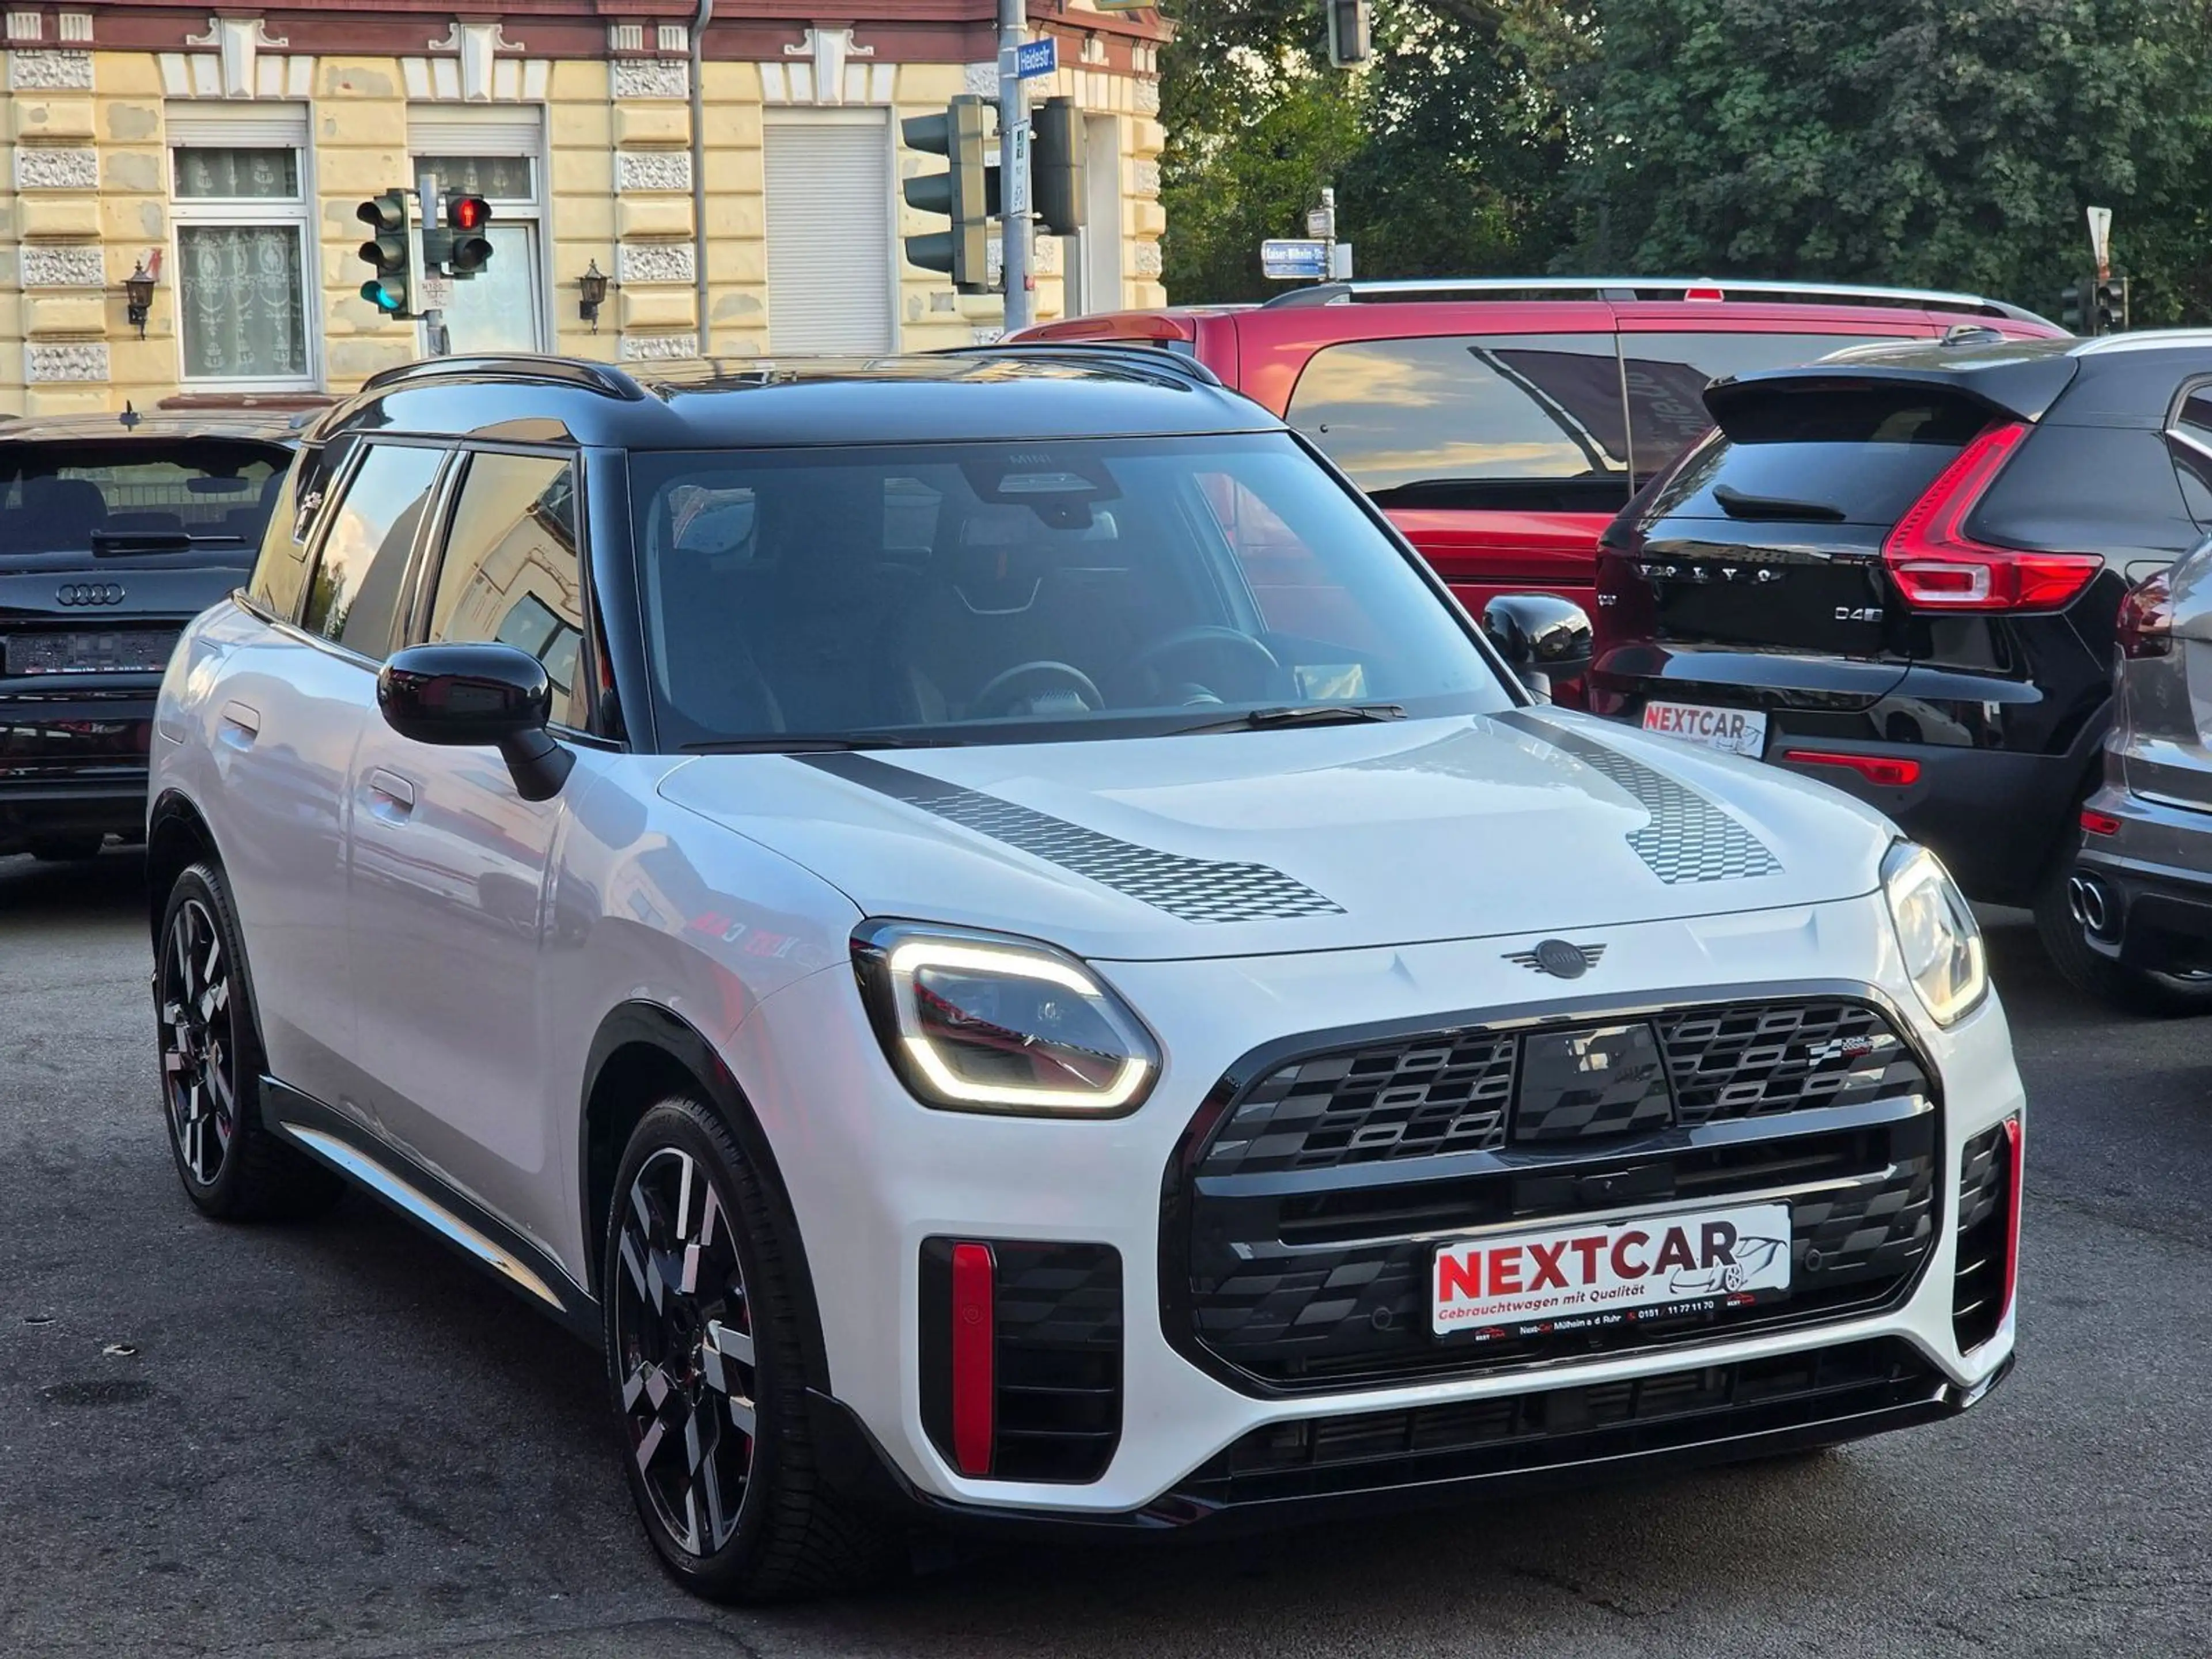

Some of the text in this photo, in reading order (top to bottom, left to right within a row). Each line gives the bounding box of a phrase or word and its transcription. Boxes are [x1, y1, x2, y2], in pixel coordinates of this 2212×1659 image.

[1009, 453, 1052, 464] MINI
[1645, 706, 1745, 739] NEXTCAR
[1438, 1220, 1738, 1302] NEXTCAR
[1438, 1284, 1645, 1320] Gebrauchtwagen mit Qualität
[1603, 1315, 1622, 1324] Ruhr
